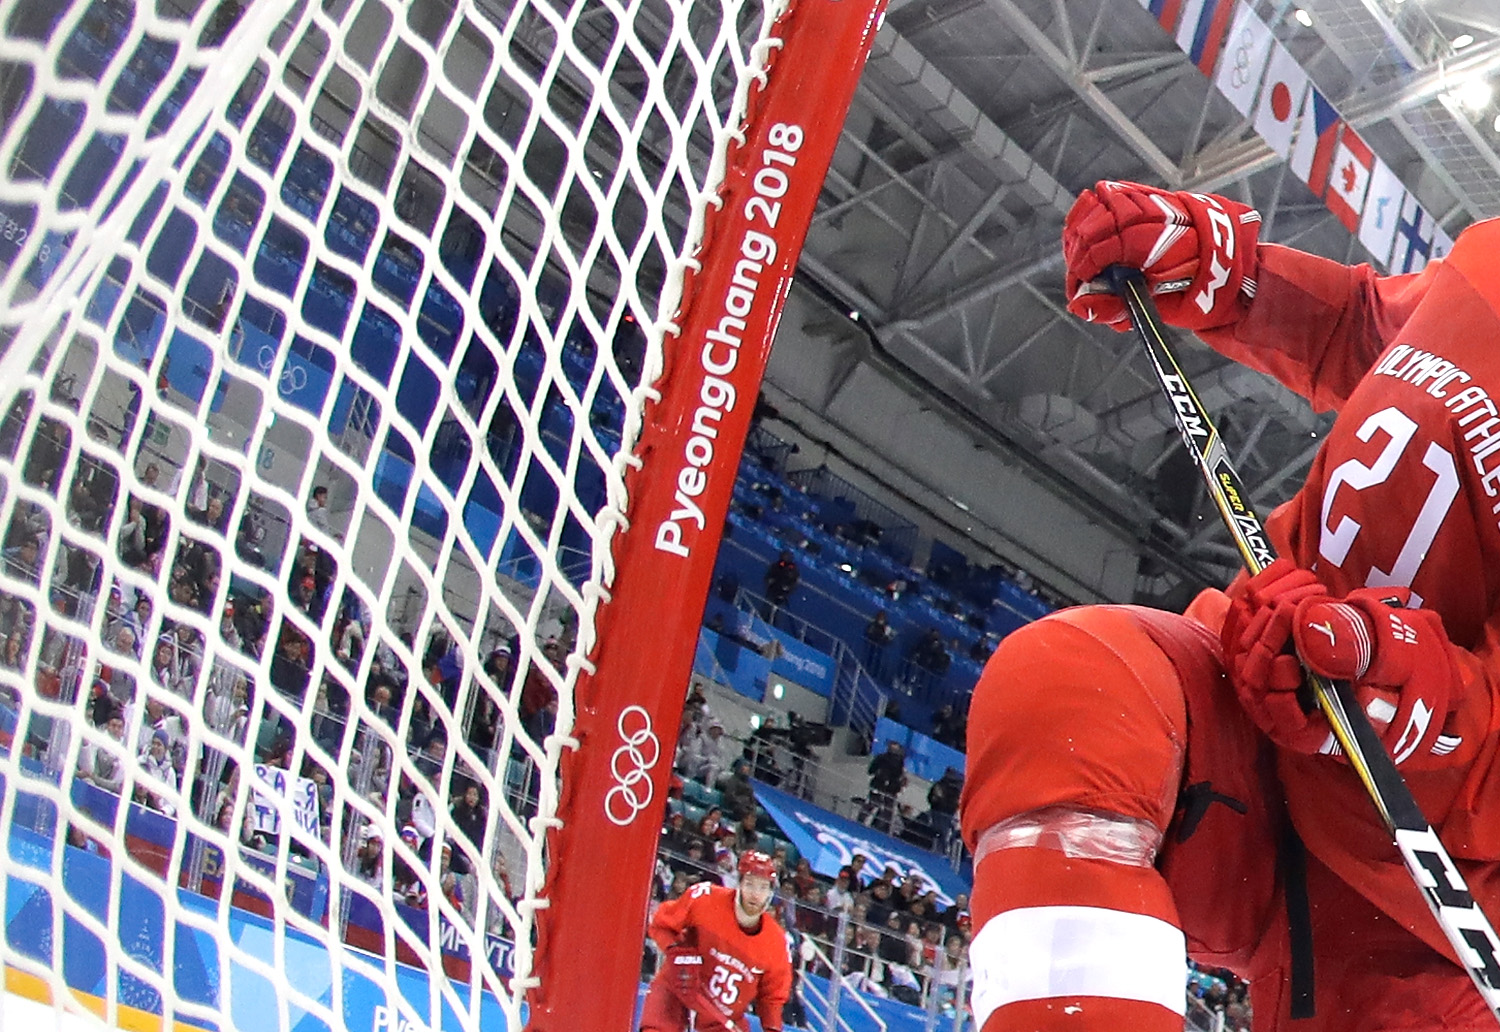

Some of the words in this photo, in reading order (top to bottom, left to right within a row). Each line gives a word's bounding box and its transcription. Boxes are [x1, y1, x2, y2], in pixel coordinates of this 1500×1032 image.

[654, 229, 778, 558] PyeongChang
[744, 122, 805, 229] 2018
[1373, 344, 1472, 398] OLYMPIC
[1163, 374, 1208, 438] CCM
[1219, 472, 1245, 511] SUPER
[1318, 405, 1461, 609] 21
[709, 965, 743, 1005] 25
